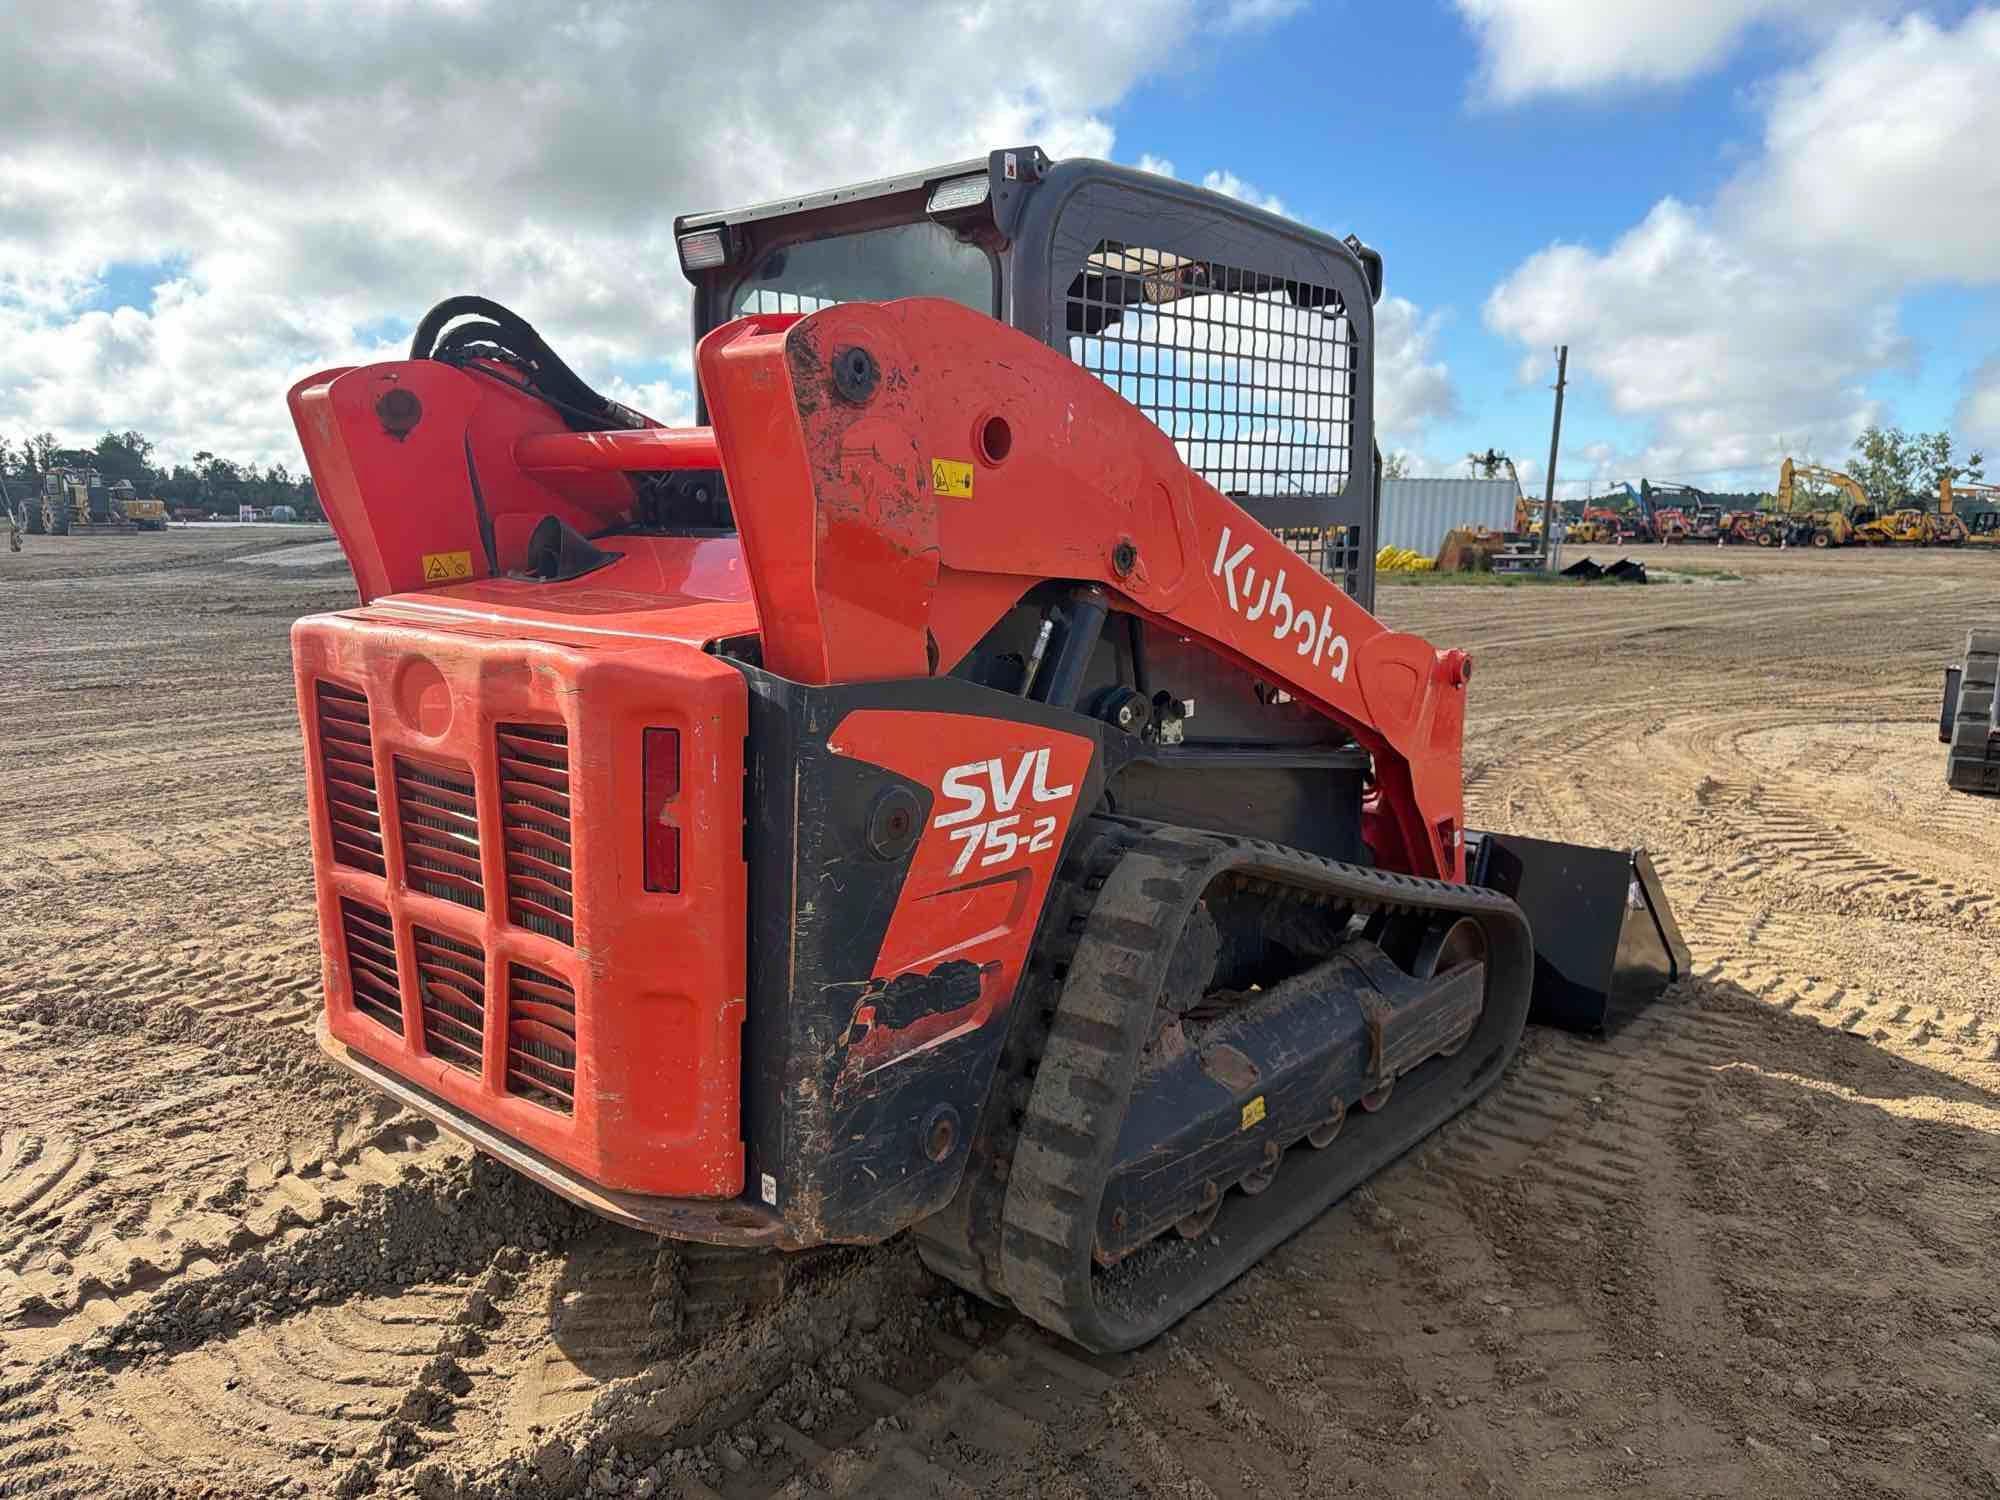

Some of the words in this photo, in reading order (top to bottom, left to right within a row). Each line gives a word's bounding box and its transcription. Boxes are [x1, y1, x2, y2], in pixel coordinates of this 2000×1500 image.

[1212, 526, 1350, 684] Kubota
[934, 747, 1073, 829] SVL
[948, 814, 1057, 877] 75-2
